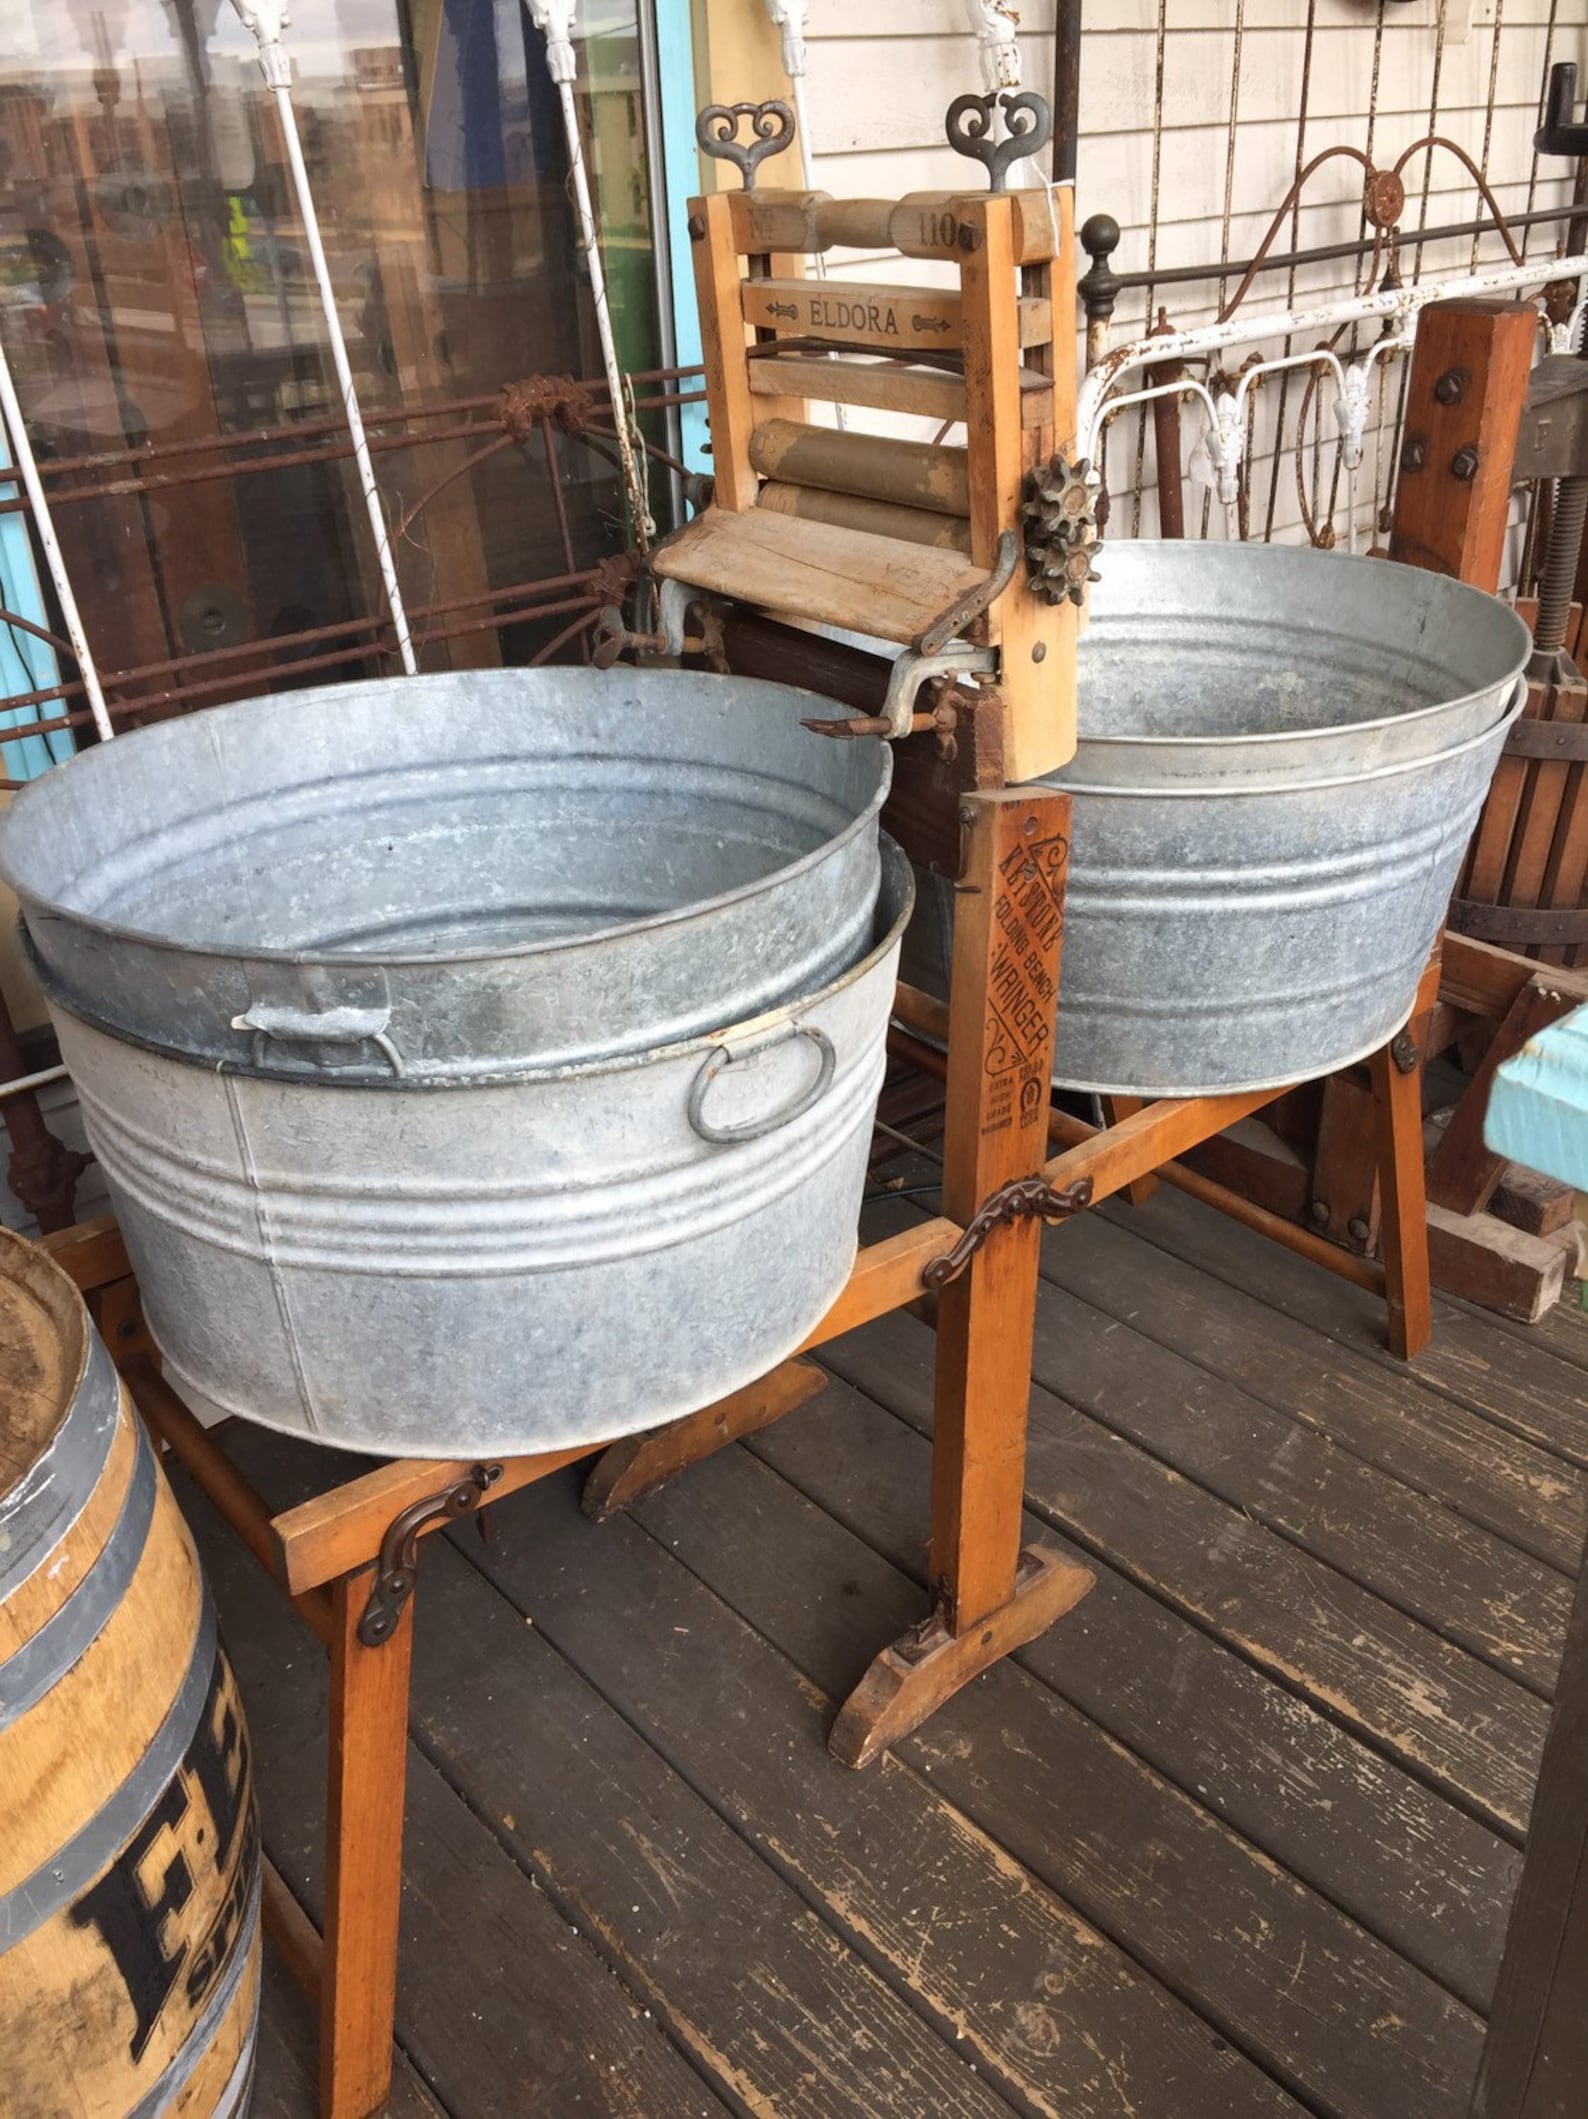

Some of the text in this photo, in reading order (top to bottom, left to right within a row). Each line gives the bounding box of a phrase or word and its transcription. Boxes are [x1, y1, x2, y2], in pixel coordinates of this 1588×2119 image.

[918, 211, 958, 248] 110
[808, 299, 899, 335] ELDORA
[995, 895, 1056, 1003] FOLDING BENCH
[990, 943, 1049, 1057] WRINGER
